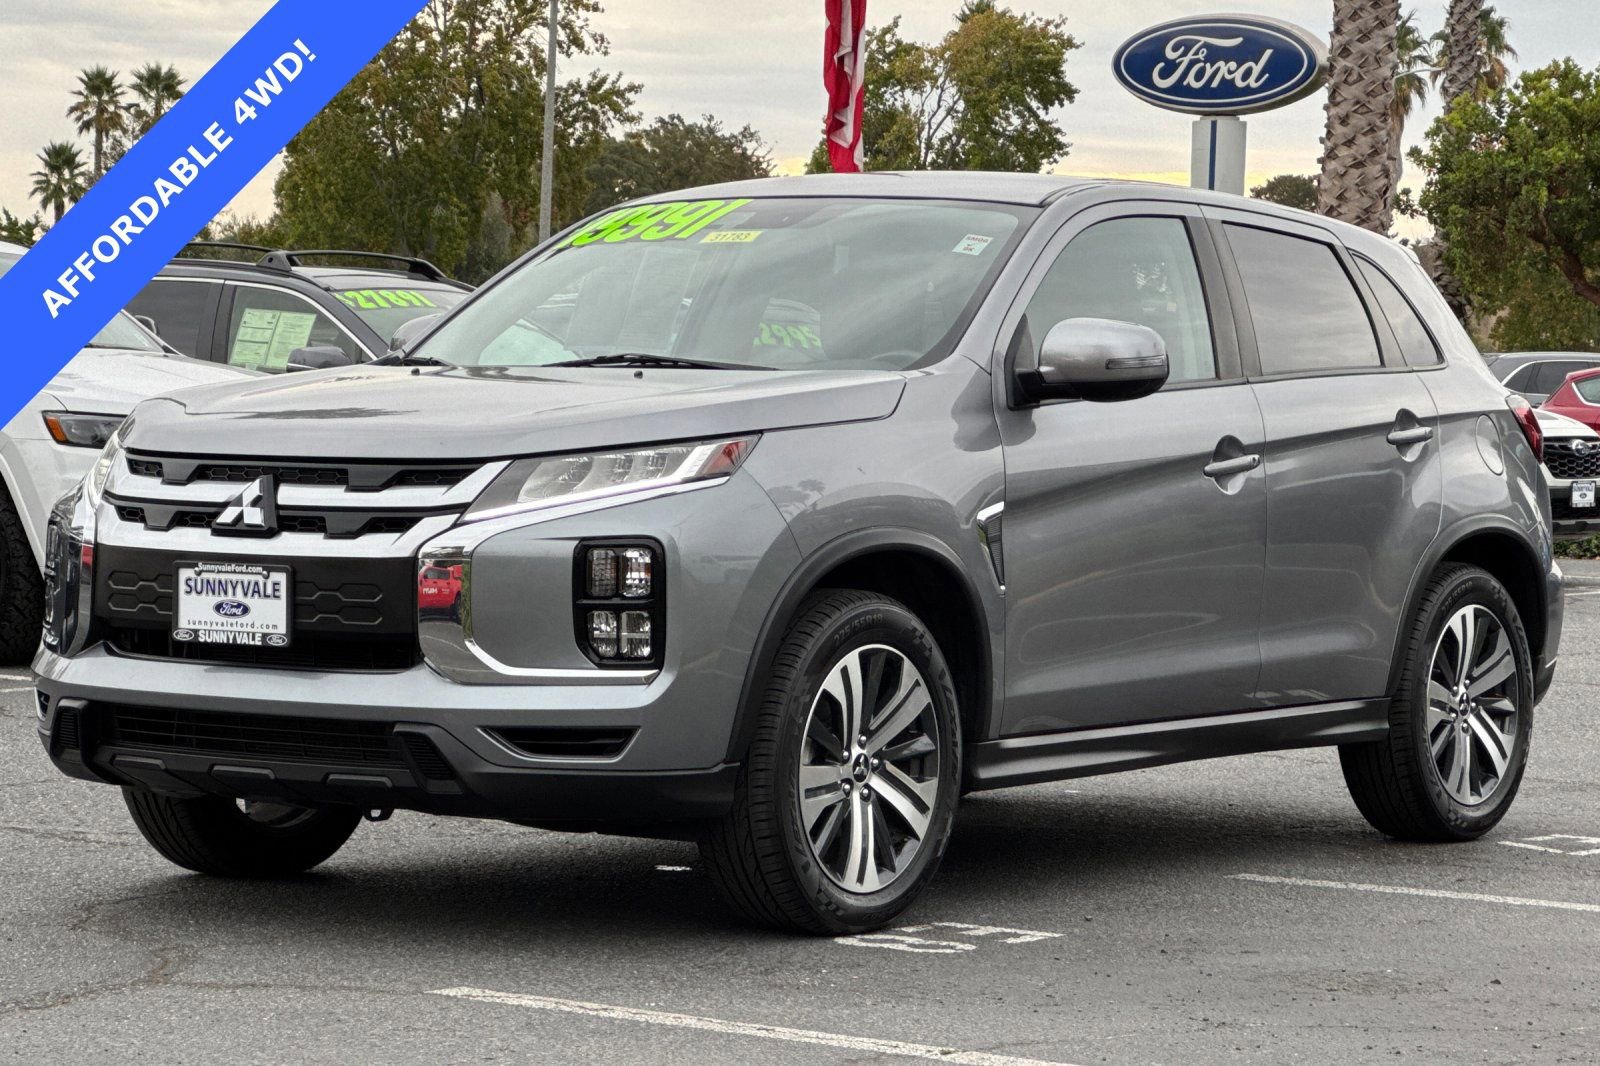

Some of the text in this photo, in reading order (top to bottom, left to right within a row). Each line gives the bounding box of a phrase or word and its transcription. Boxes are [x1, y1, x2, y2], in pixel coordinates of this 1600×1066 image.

[1152, 35, 1273, 89] Ford
[198, 562, 263, 574] SunnyvaleFord.com
[185, 577, 281, 599] SUNNYVALE
[220, 602, 244, 616] Ford
[187, 619, 278, 631] sunnyvaleford.com
[198, 629, 262, 645] SUNNYVALE
